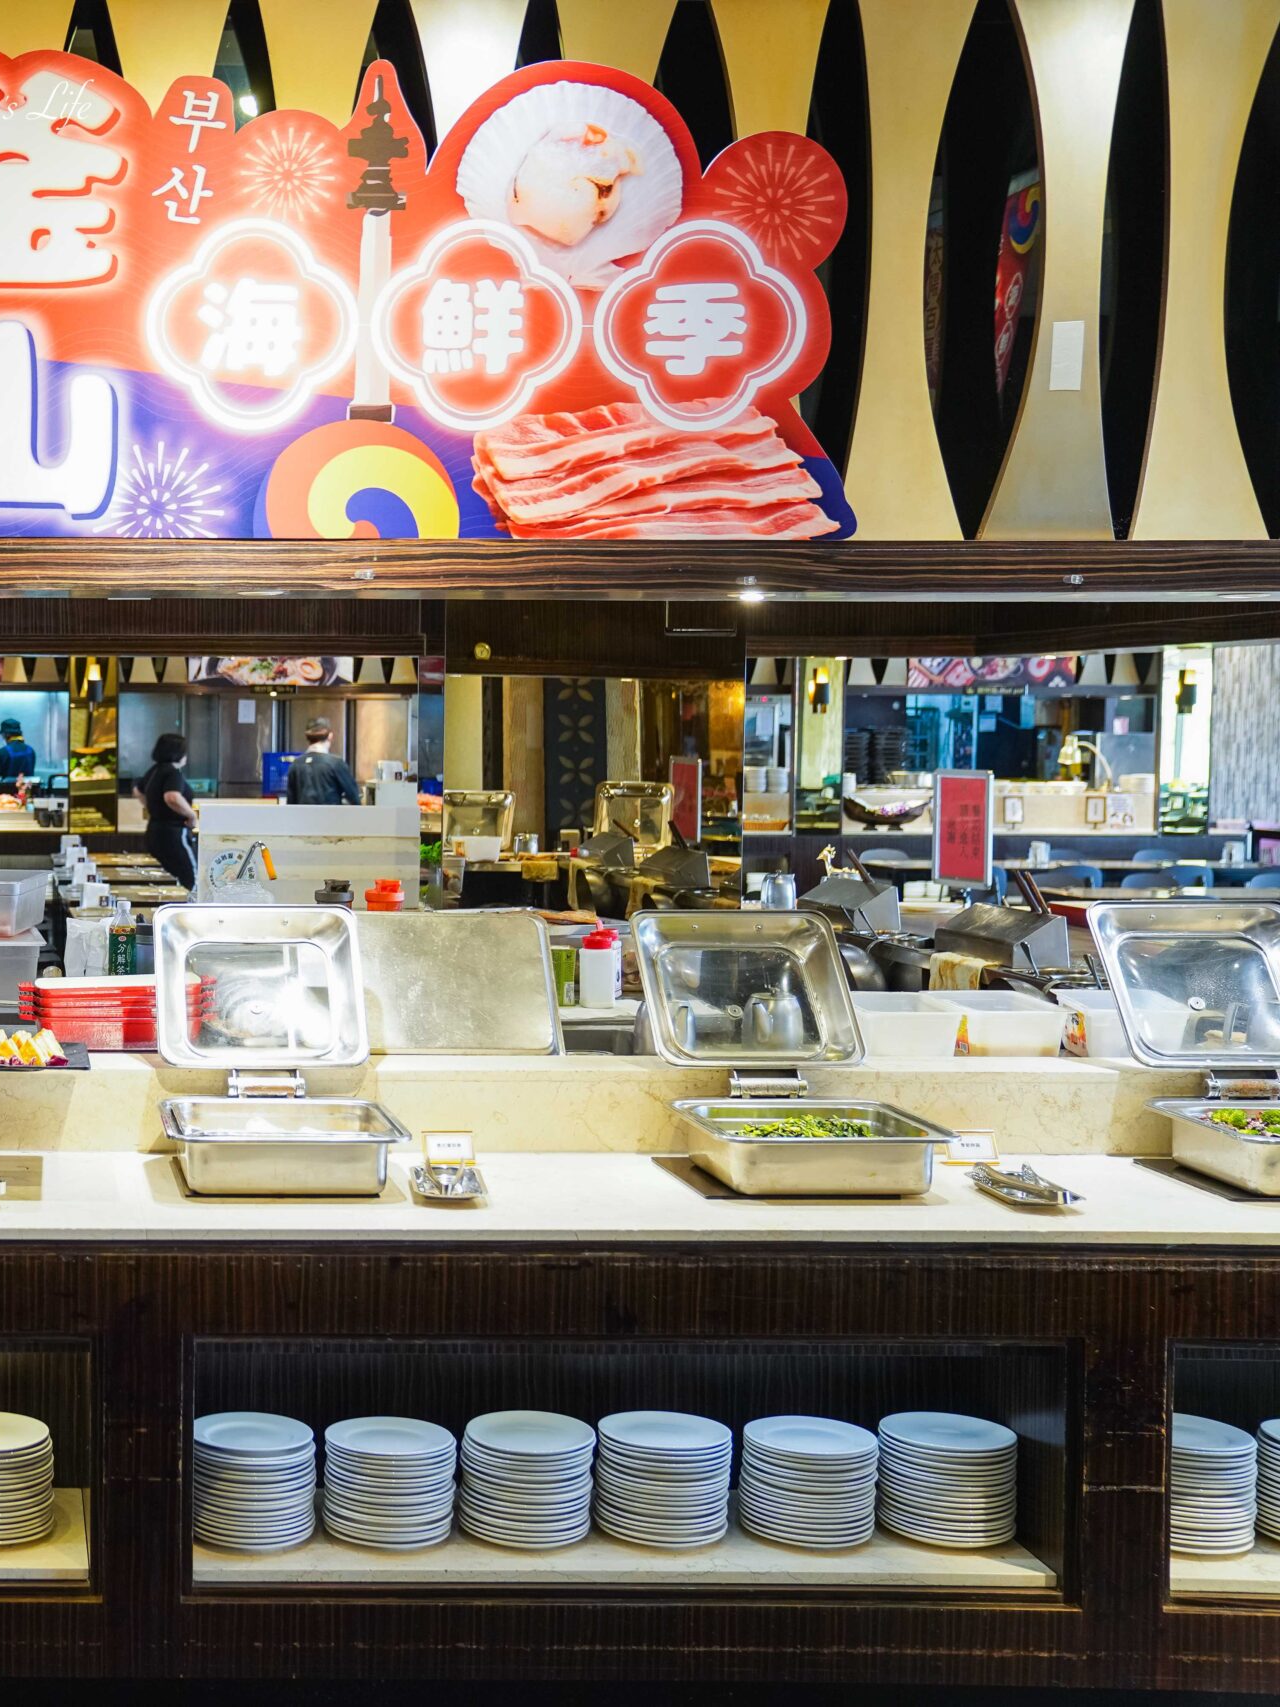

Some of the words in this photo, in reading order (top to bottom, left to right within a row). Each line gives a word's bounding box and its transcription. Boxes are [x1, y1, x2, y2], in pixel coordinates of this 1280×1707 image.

[151, 90, 226, 224] 부산
[197, 277, 749, 380] 海鮮季
